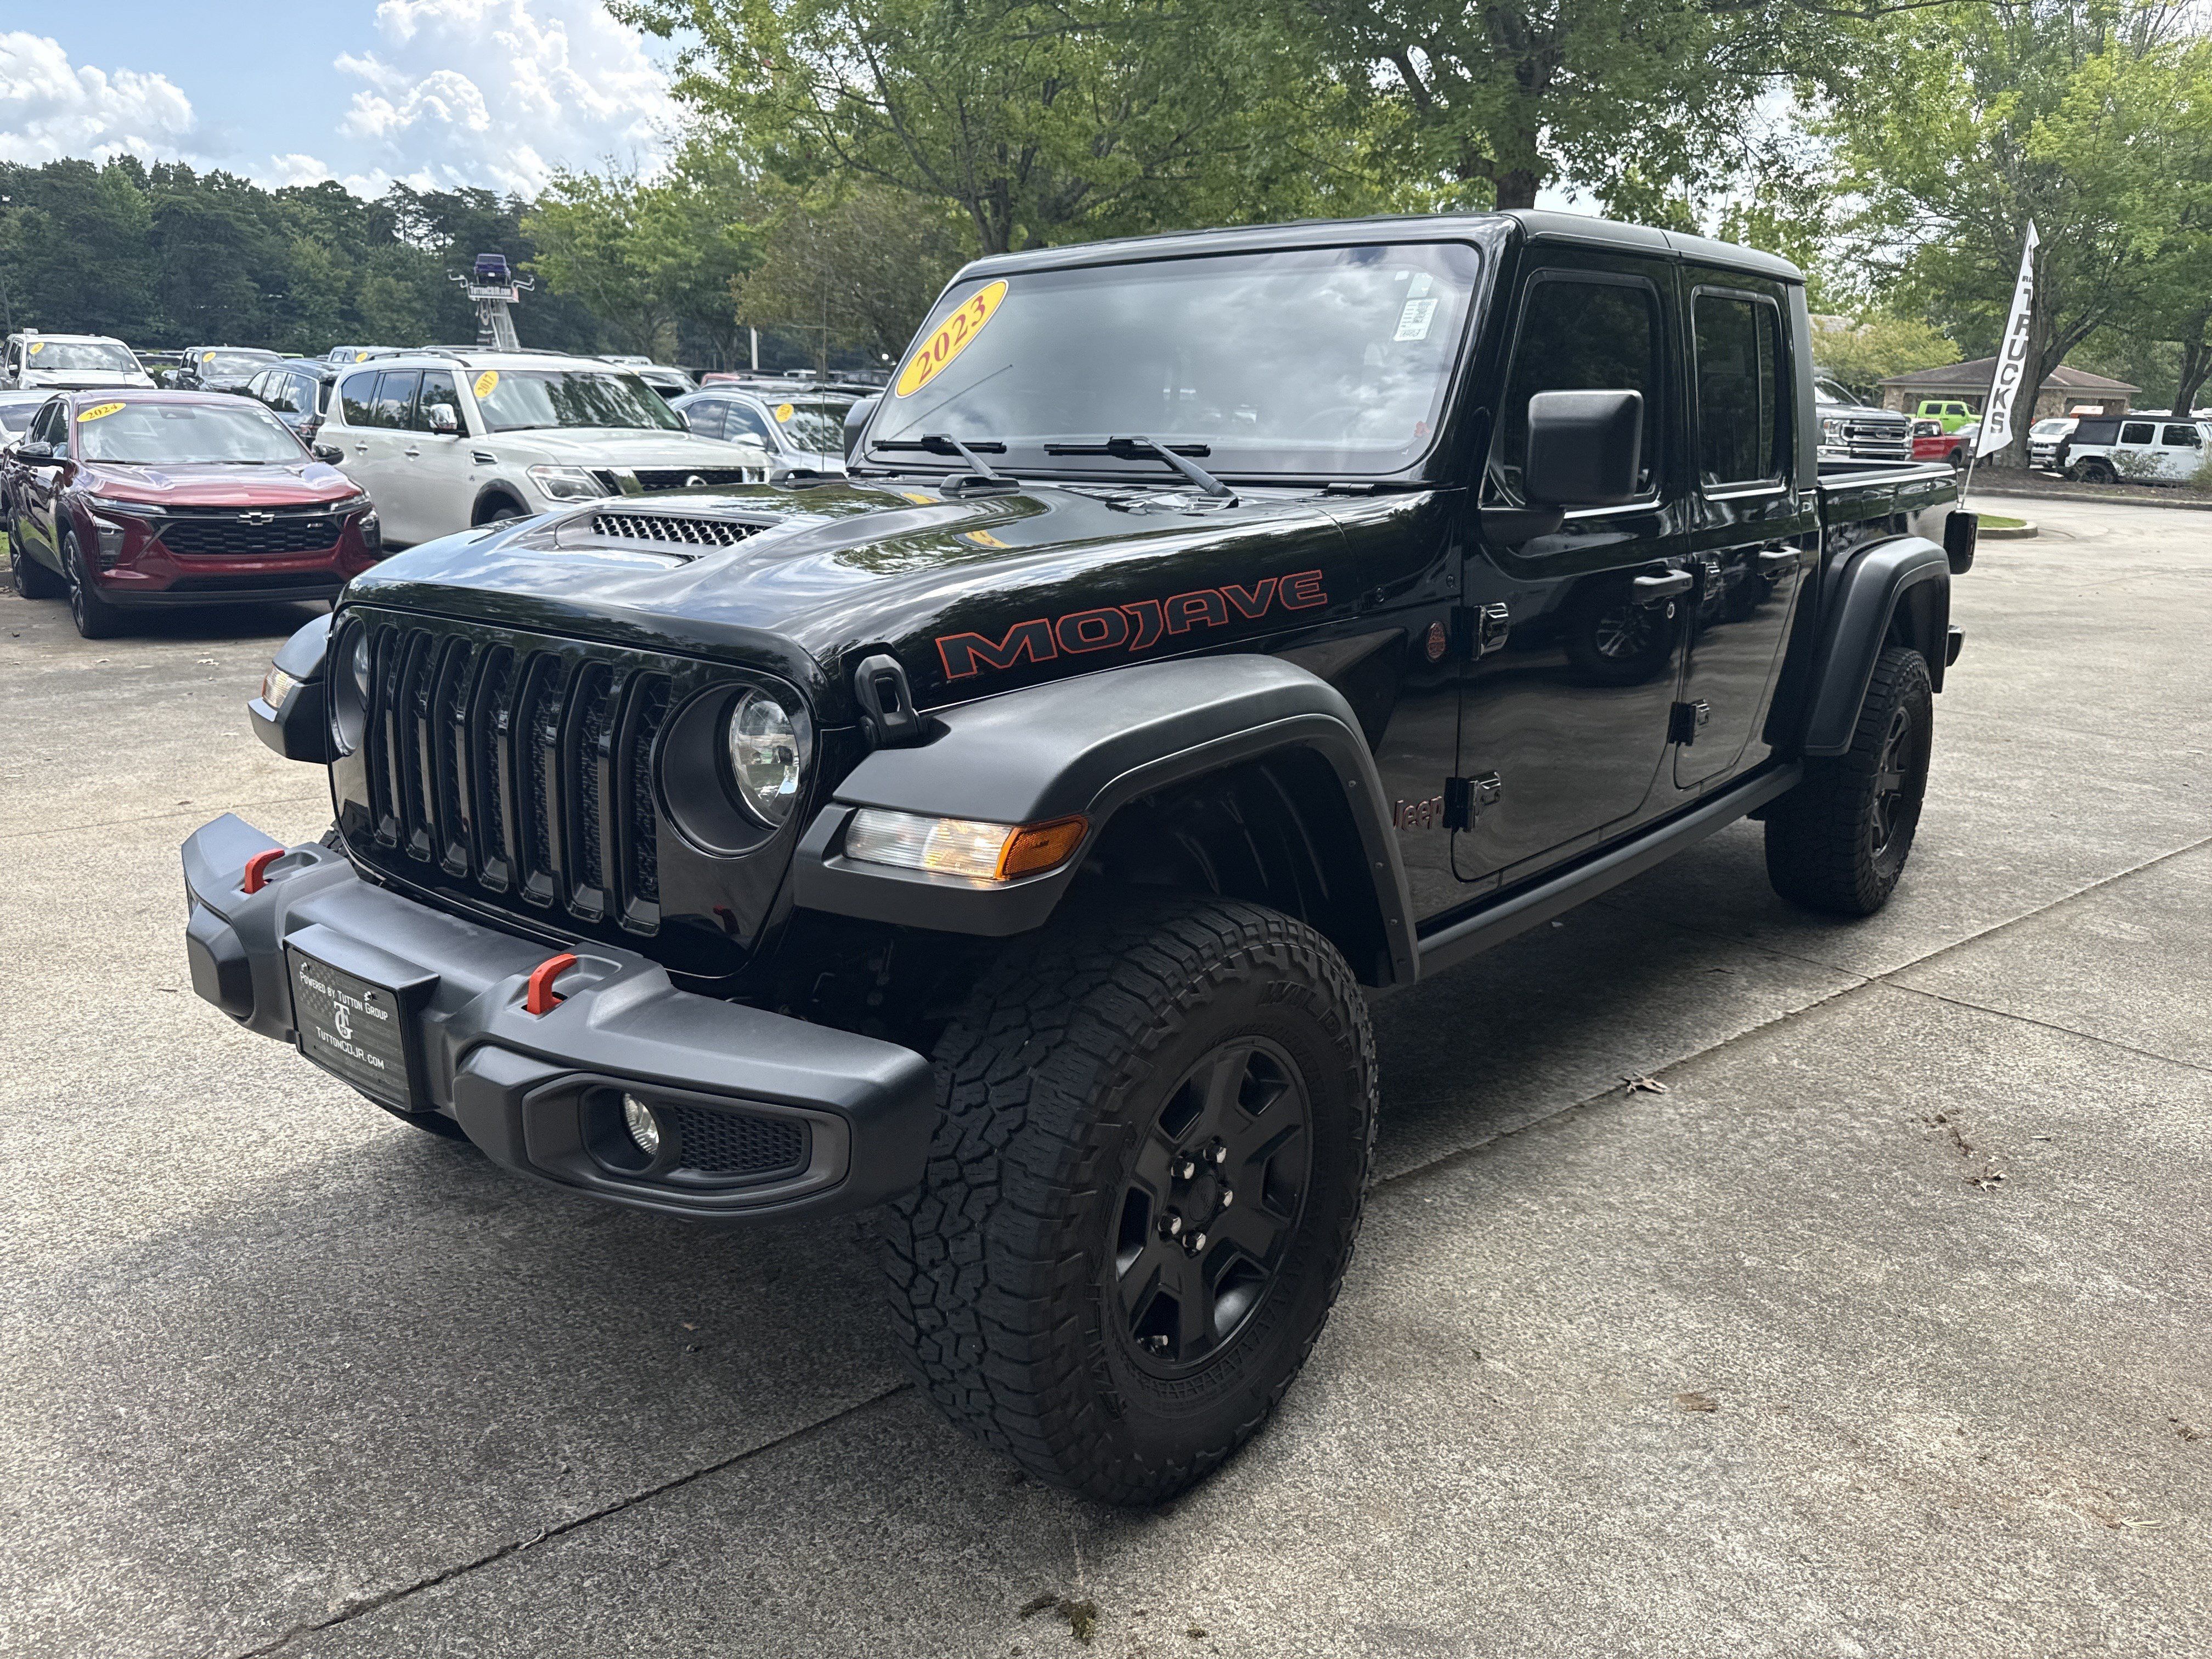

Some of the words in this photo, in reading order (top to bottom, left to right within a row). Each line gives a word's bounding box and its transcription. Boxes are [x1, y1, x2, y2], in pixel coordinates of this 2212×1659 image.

[917, 295, 986, 385] 2023
[1990, 288, 2032, 434] TRUCKS
[86, 404, 117, 419] 2024
[935, 569, 1328, 680] MOJAVE
[1393, 795, 1444, 832] Jeep
[300, 971, 326, 994] POWERED
[328, 986, 335, 998] BY
[337, 990, 363, 1011] TUTTON
[365, 1002, 388, 1021] GROUP
[315, 1026, 385, 1070] TUTTONCDJR.COM
